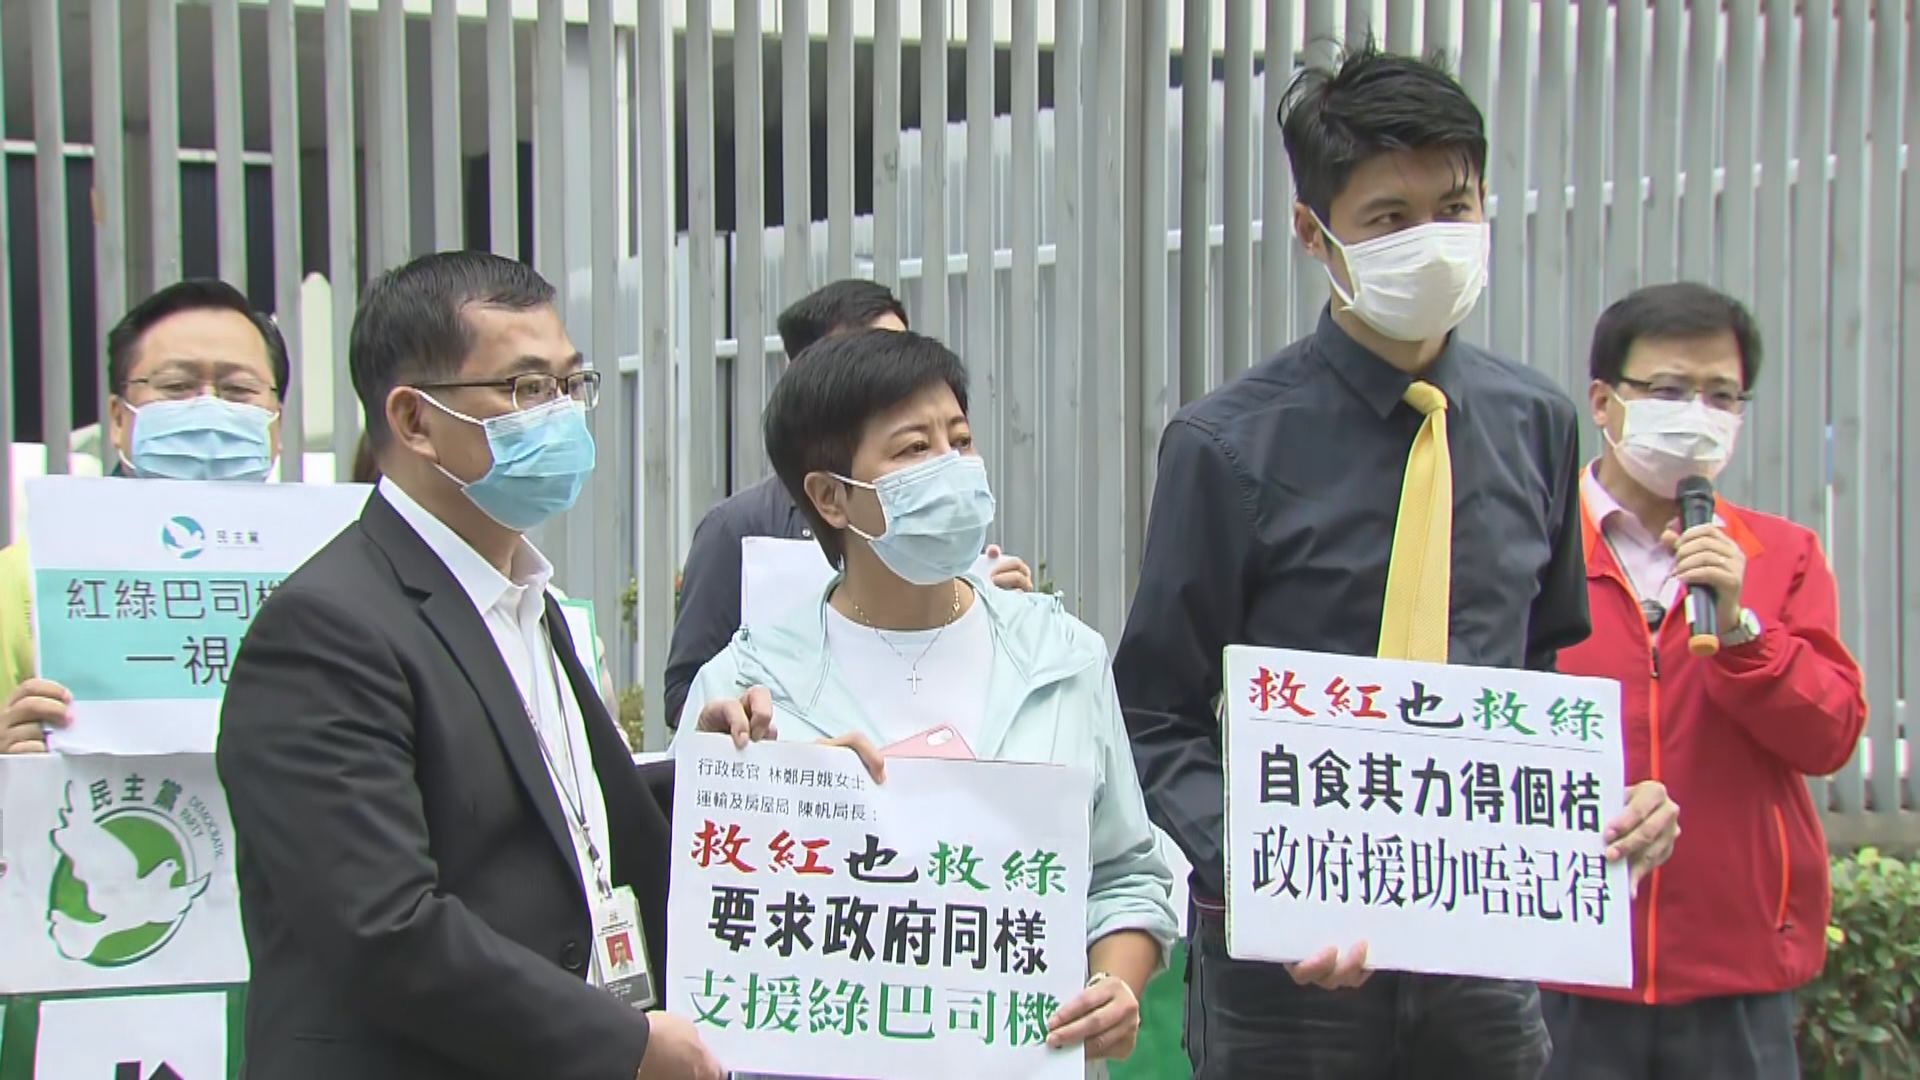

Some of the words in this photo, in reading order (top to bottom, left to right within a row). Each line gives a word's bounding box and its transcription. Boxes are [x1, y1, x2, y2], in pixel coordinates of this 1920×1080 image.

[216, 530, 260, 545] 民主黨
[125, 635, 246, 686] 一視
[1248, 666, 1605, 742] 救紅也救綠
[89, 772, 183, 812] 民主黨
[696, 789, 790, 816] 運輸及房屋局
[697, 758, 760, 781] 行政長官
[768, 766, 866, 791] 林鄭月娥女士
[1259, 744, 1601, 833] 自食其力得個桔
[180, 808, 205, 838] PARTY
[690, 819, 1067, 896] 救紅也救綠
[1252, 823, 1611, 925] 政府援助唔記得
[707, 884, 1048, 976] 要求政府同樣
[684, 968, 1060, 1048] 支援綠巴司機
